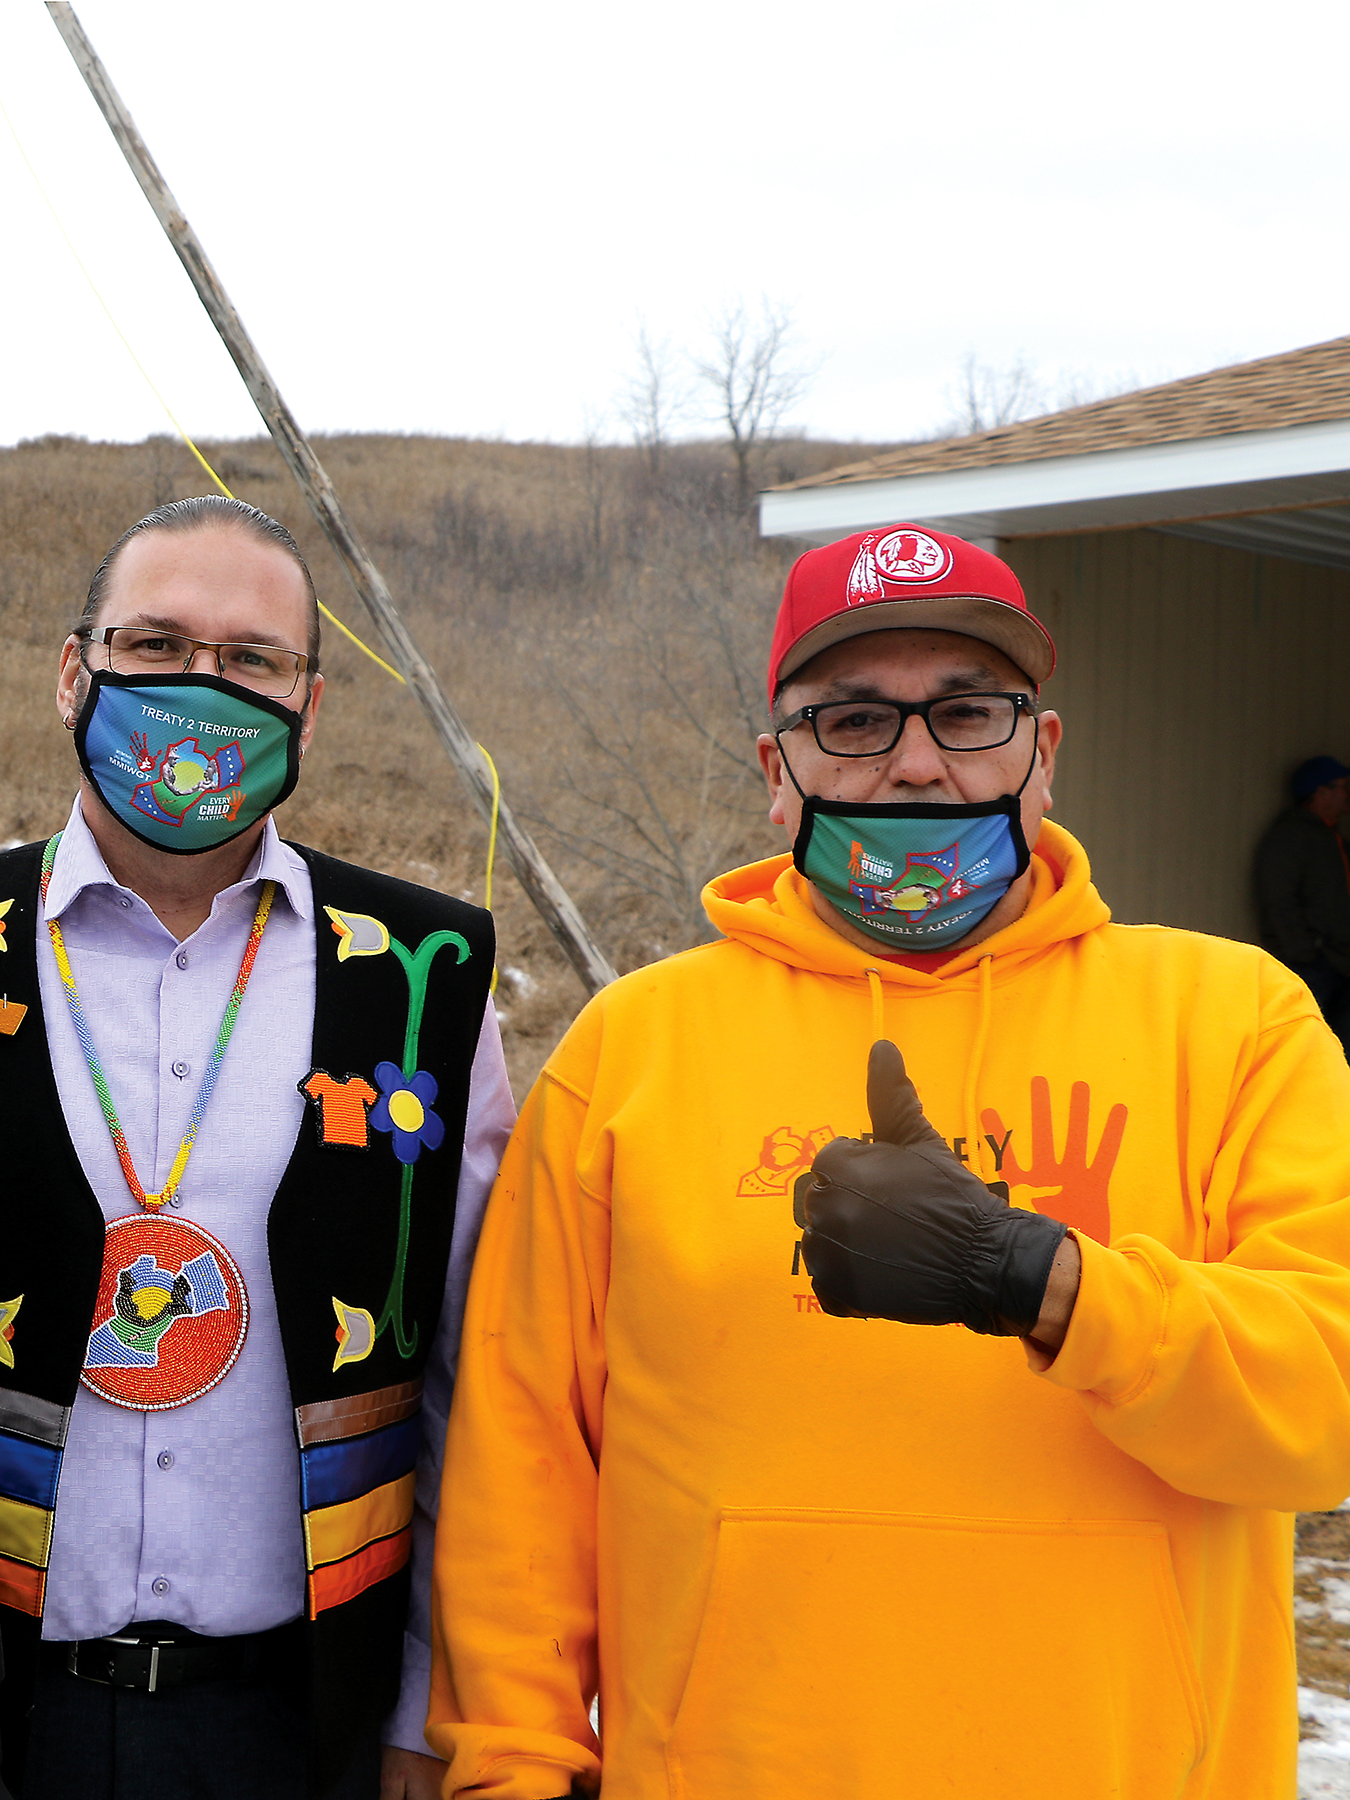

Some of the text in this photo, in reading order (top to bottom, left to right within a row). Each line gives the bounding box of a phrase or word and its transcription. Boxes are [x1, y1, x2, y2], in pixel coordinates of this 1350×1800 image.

[141, 704, 261, 738] TREATY 2 TERRITORY
[109, 756, 152, 782] MMIWGT
[209, 797, 231, 805] EVERY
[199, 804, 230, 816] CHILD
[860, 859, 893, 878] CHILD
[860, 870, 883, 883] EVERY
